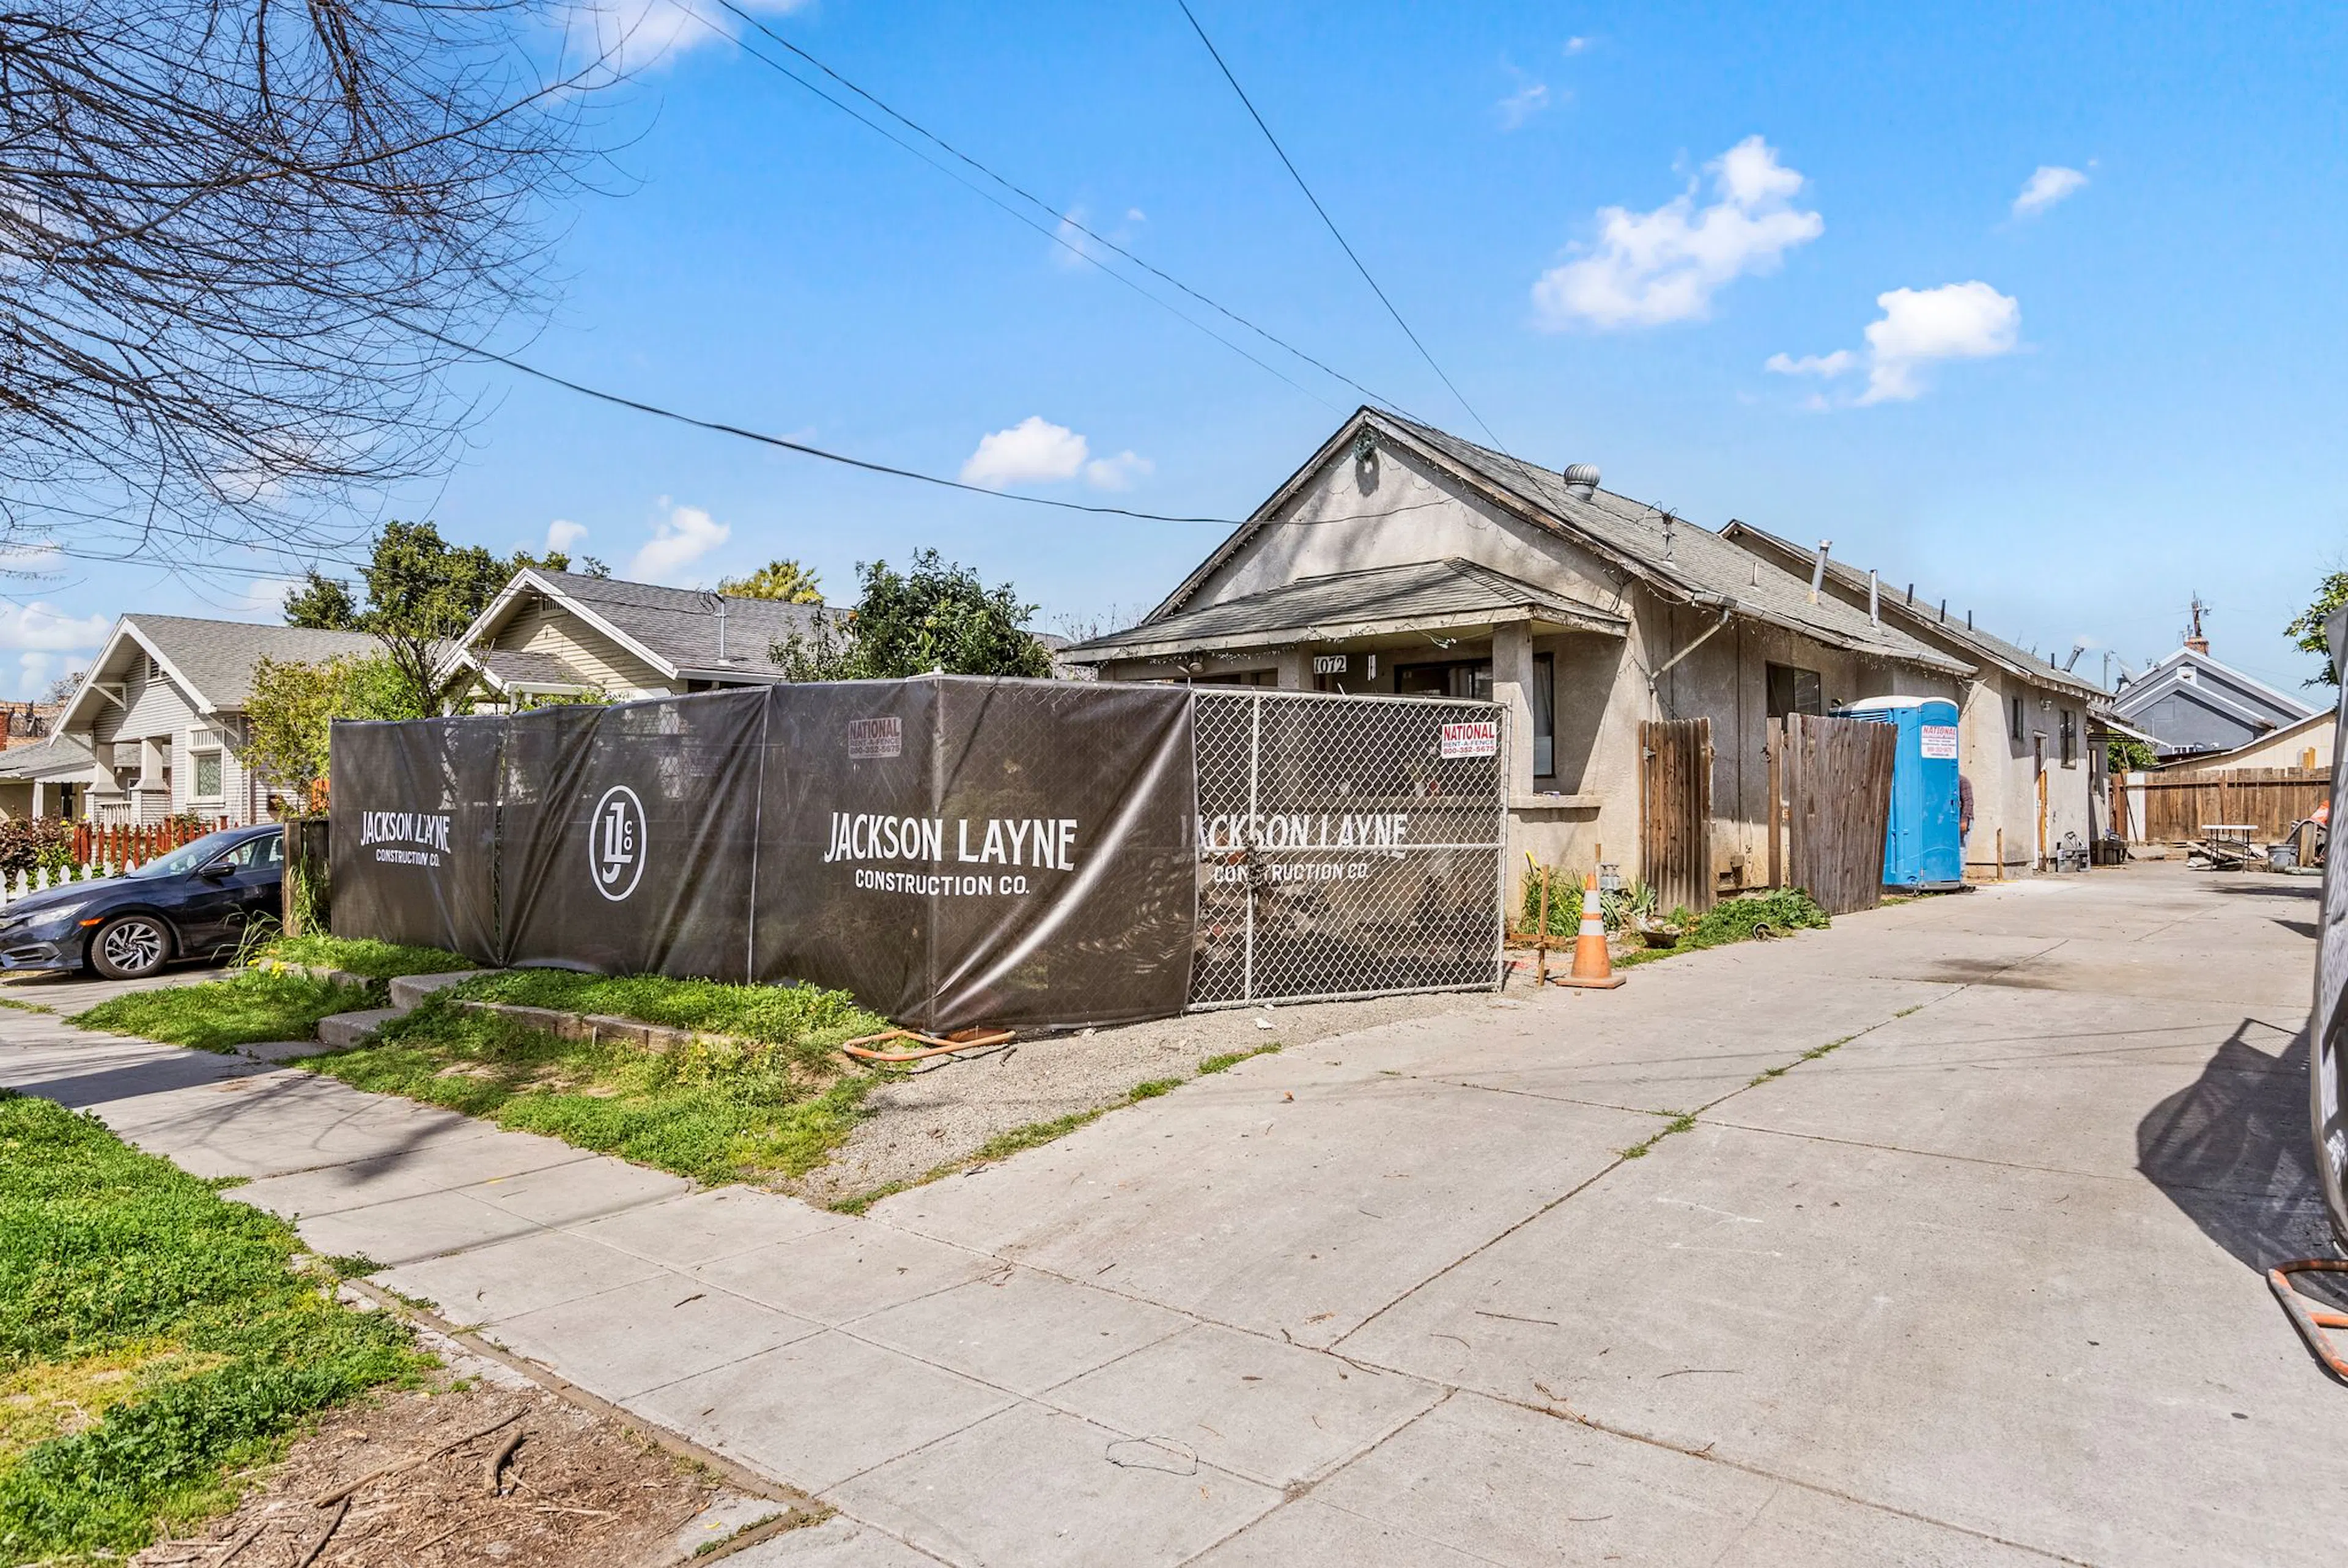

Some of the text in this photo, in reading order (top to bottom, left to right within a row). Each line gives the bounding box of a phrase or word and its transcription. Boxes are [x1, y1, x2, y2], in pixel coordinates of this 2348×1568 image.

[1315, 657, 1345, 672] 1072
[849, 719, 900, 740] NATIONAL
[1444, 724, 1495, 741] NATIONAL
[1924, 726, 1955, 735] NATIONAL
[360, 811, 451, 854] JACKSON LAYNE
[824, 811, 1078, 872] JACKSON LAYNE
[376, 848, 428, 866] CONSTRUCTION
[1214, 864, 1343, 882] CONTRUCTION
[855, 869, 1030, 896] CONSTRUCTION CO.
